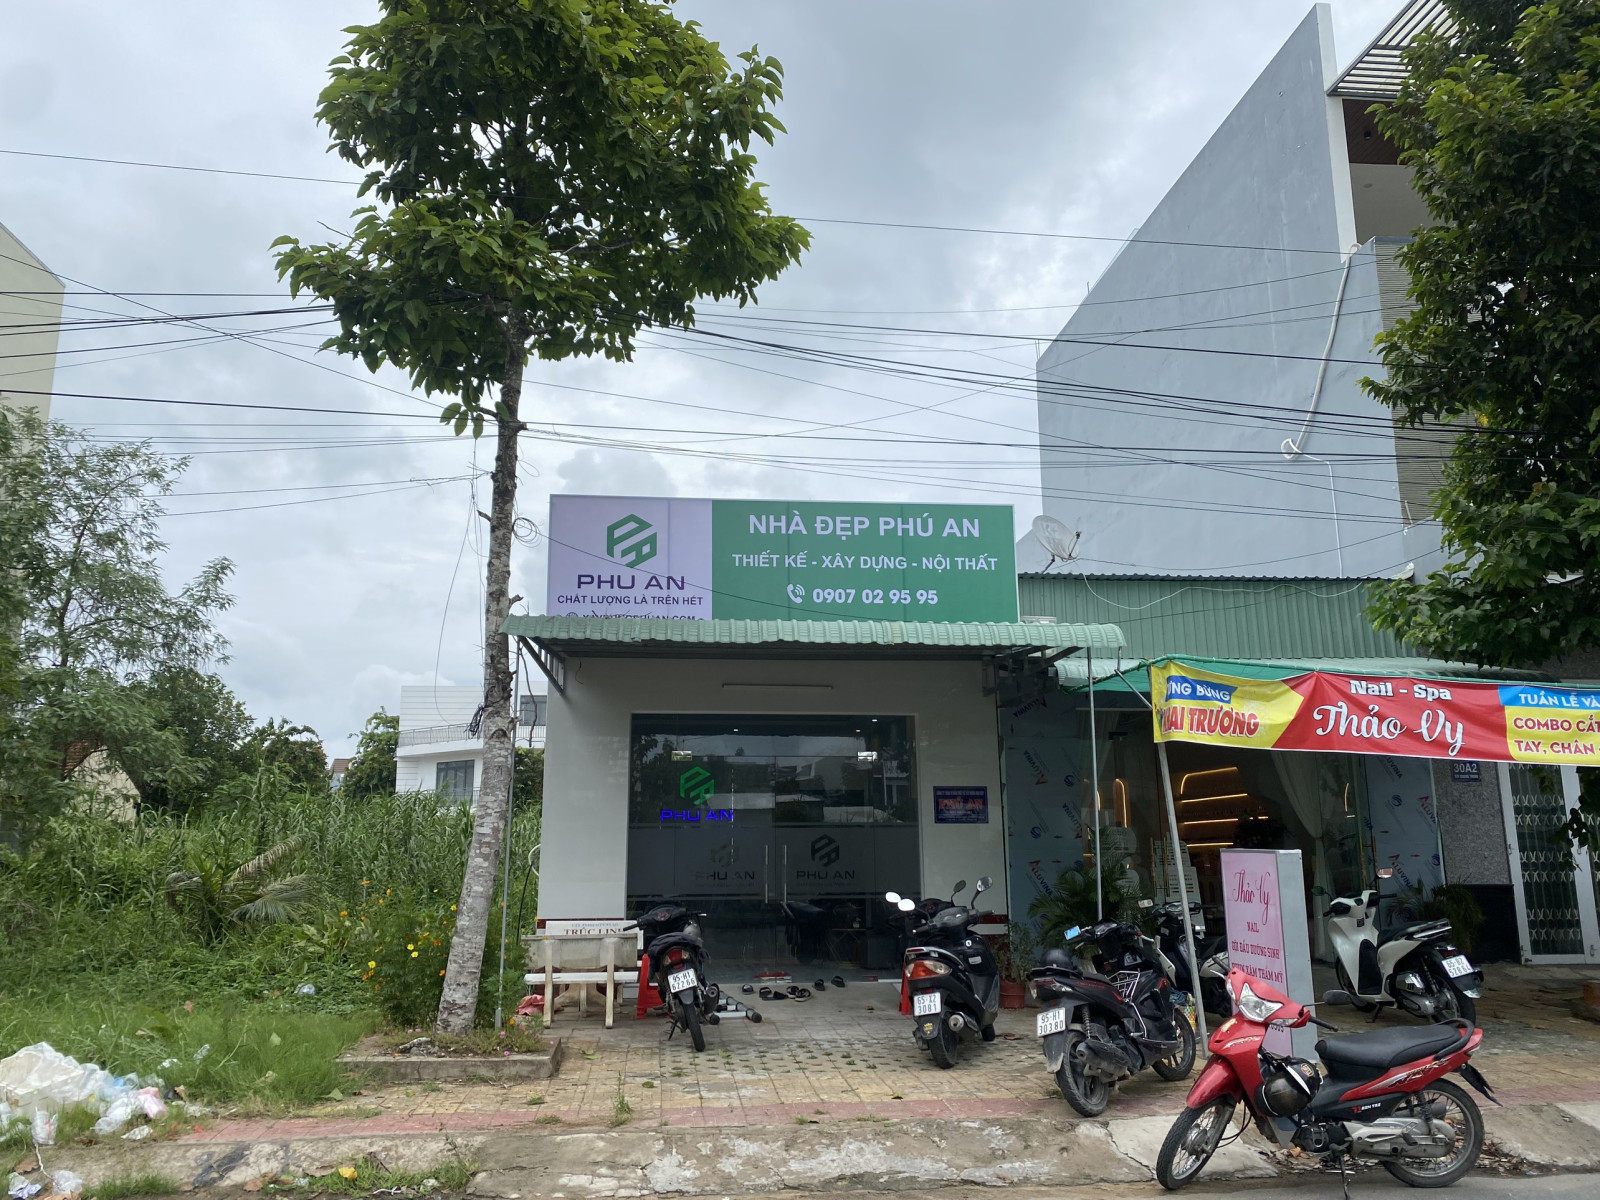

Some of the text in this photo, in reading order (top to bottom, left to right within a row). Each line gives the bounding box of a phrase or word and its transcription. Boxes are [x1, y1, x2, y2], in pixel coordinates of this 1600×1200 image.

[749, 510, 980, 541] NHÀ ĐẸP PHÚ AN
[732, 550, 780, 568] THIẾT
[785, 551, 807, 568] KẾ
[821, 552, 855, 569] XÂY
[860, 555, 908, 573] DỰNG
[922, 553, 951, 573] NỘI
[954, 553, 998, 570] THẤT
[577, 574, 685, 591] PHU AN
[590, 595, 631, 606] LƯỢNG
[634, 593, 648, 605] LÀ
[650, 594, 680, 605] TRÊN
[812, 588, 939, 605] 0907 02 95 95
[1349, 680, 1394, 697] Nail
[1413, 684, 1453, 702] Spa
[1561, 692, 1580, 708] LỄ
[1188, 703, 1260, 738] TRƯƠNG
[1513, 716, 1573, 732] COMBO
[1312, 701, 1466, 757] Thảo Vy
[1549, 738, 1596, 755] CHÂN
[1453, 763, 1478, 773] 30A2
[660, 809, 734, 822] PHU AN
[796, 870, 855, 880] PHU AN
[917, 1003, 938, 1014] 3081
[1041, 1010, 1060, 1024] 95-H1
[1039, 1019, 1064, 1035] 30380
